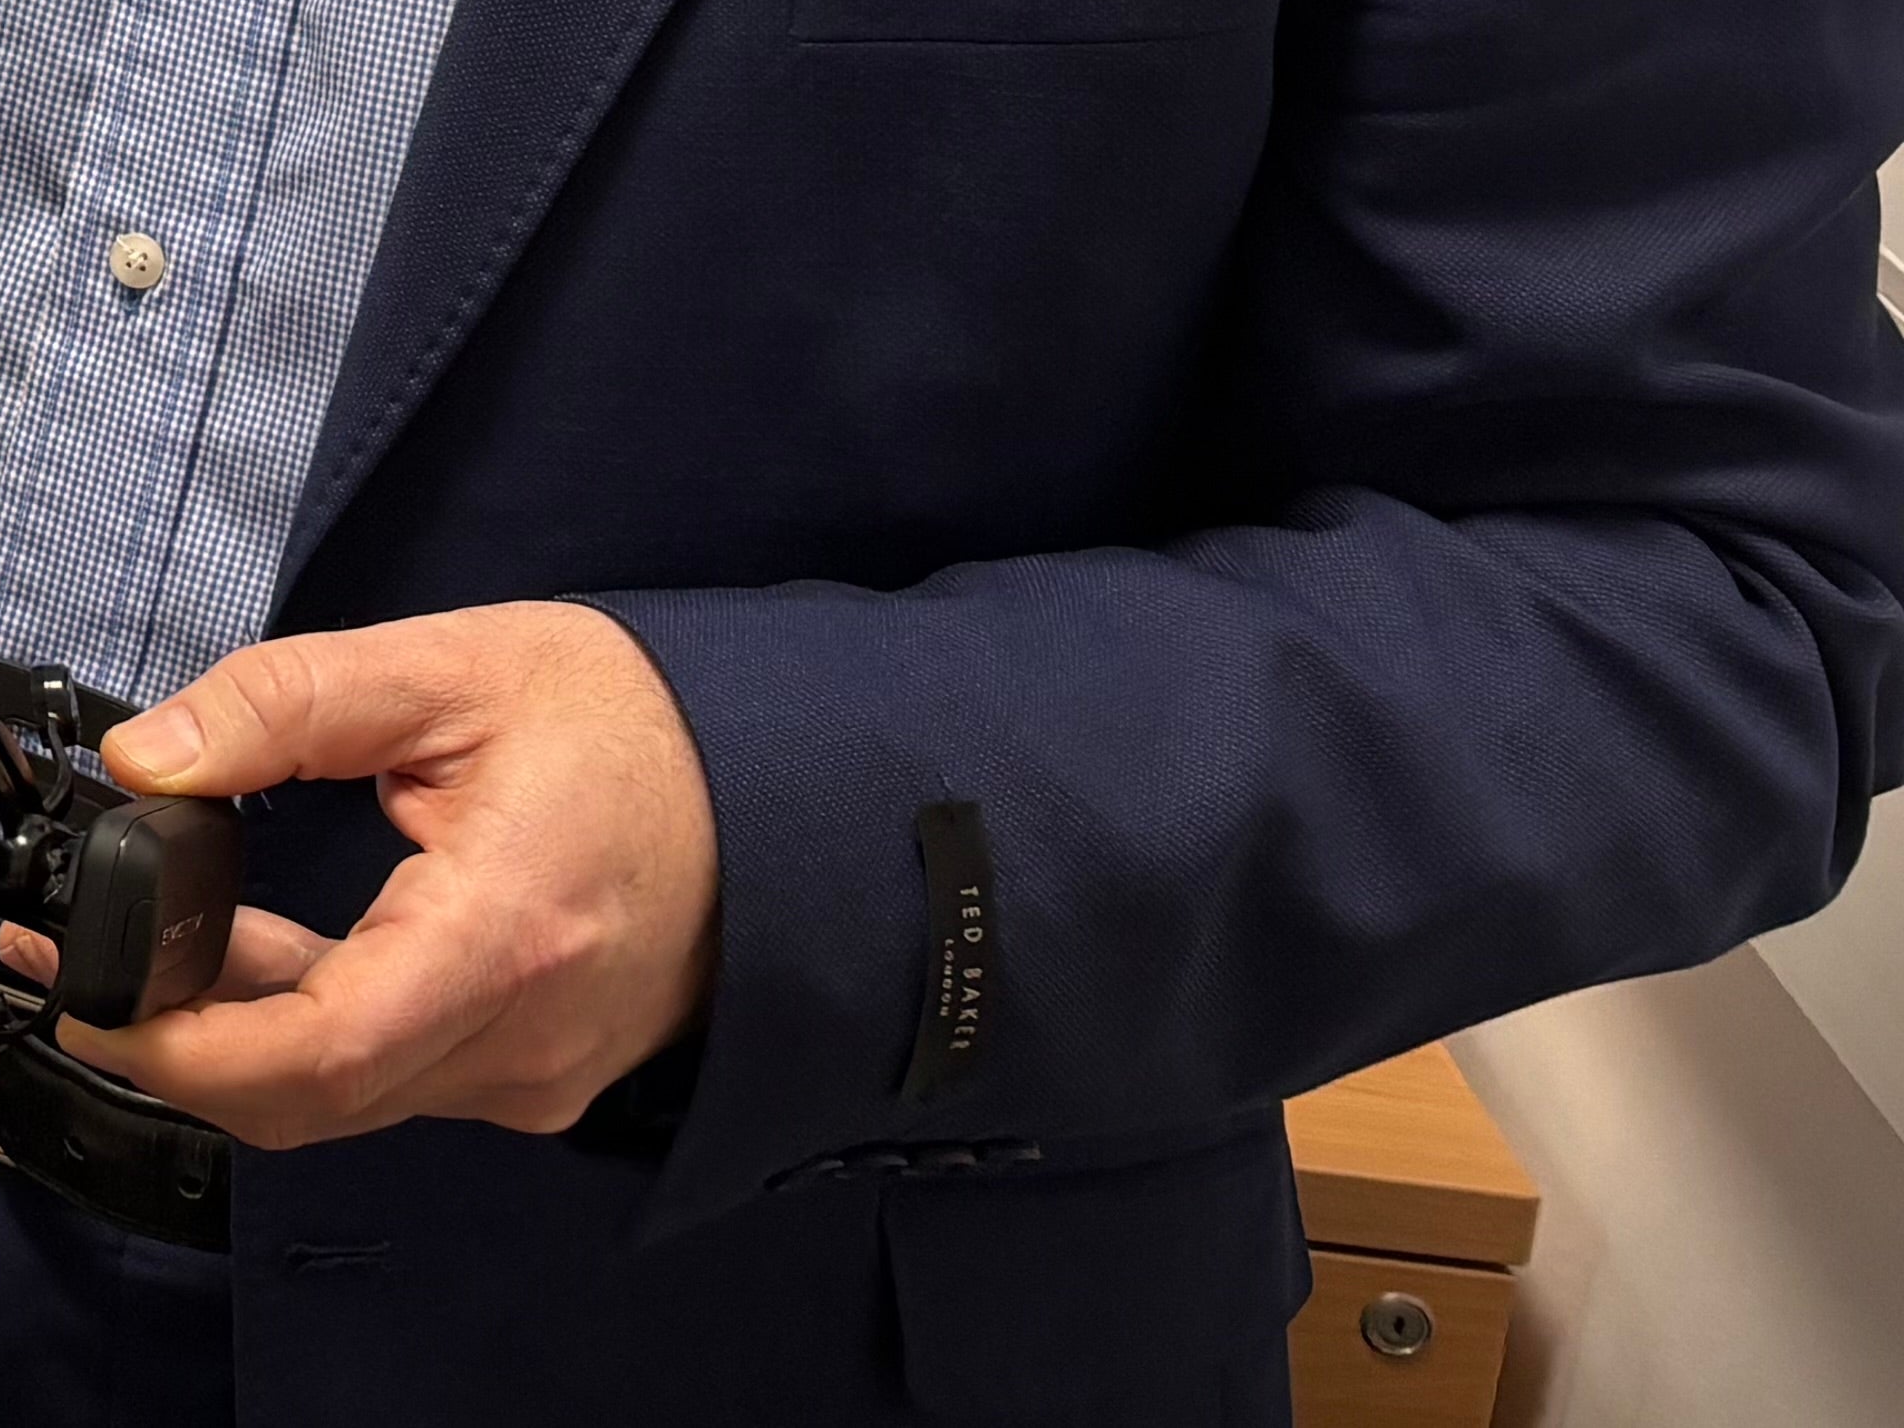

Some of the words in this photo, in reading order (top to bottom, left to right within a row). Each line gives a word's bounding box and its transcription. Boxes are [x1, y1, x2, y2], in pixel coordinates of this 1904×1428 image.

[960, 885, 983, 943] TED
[940, 938, 955, 1017] LONDON
[949, 966, 983, 1050] BAKER
